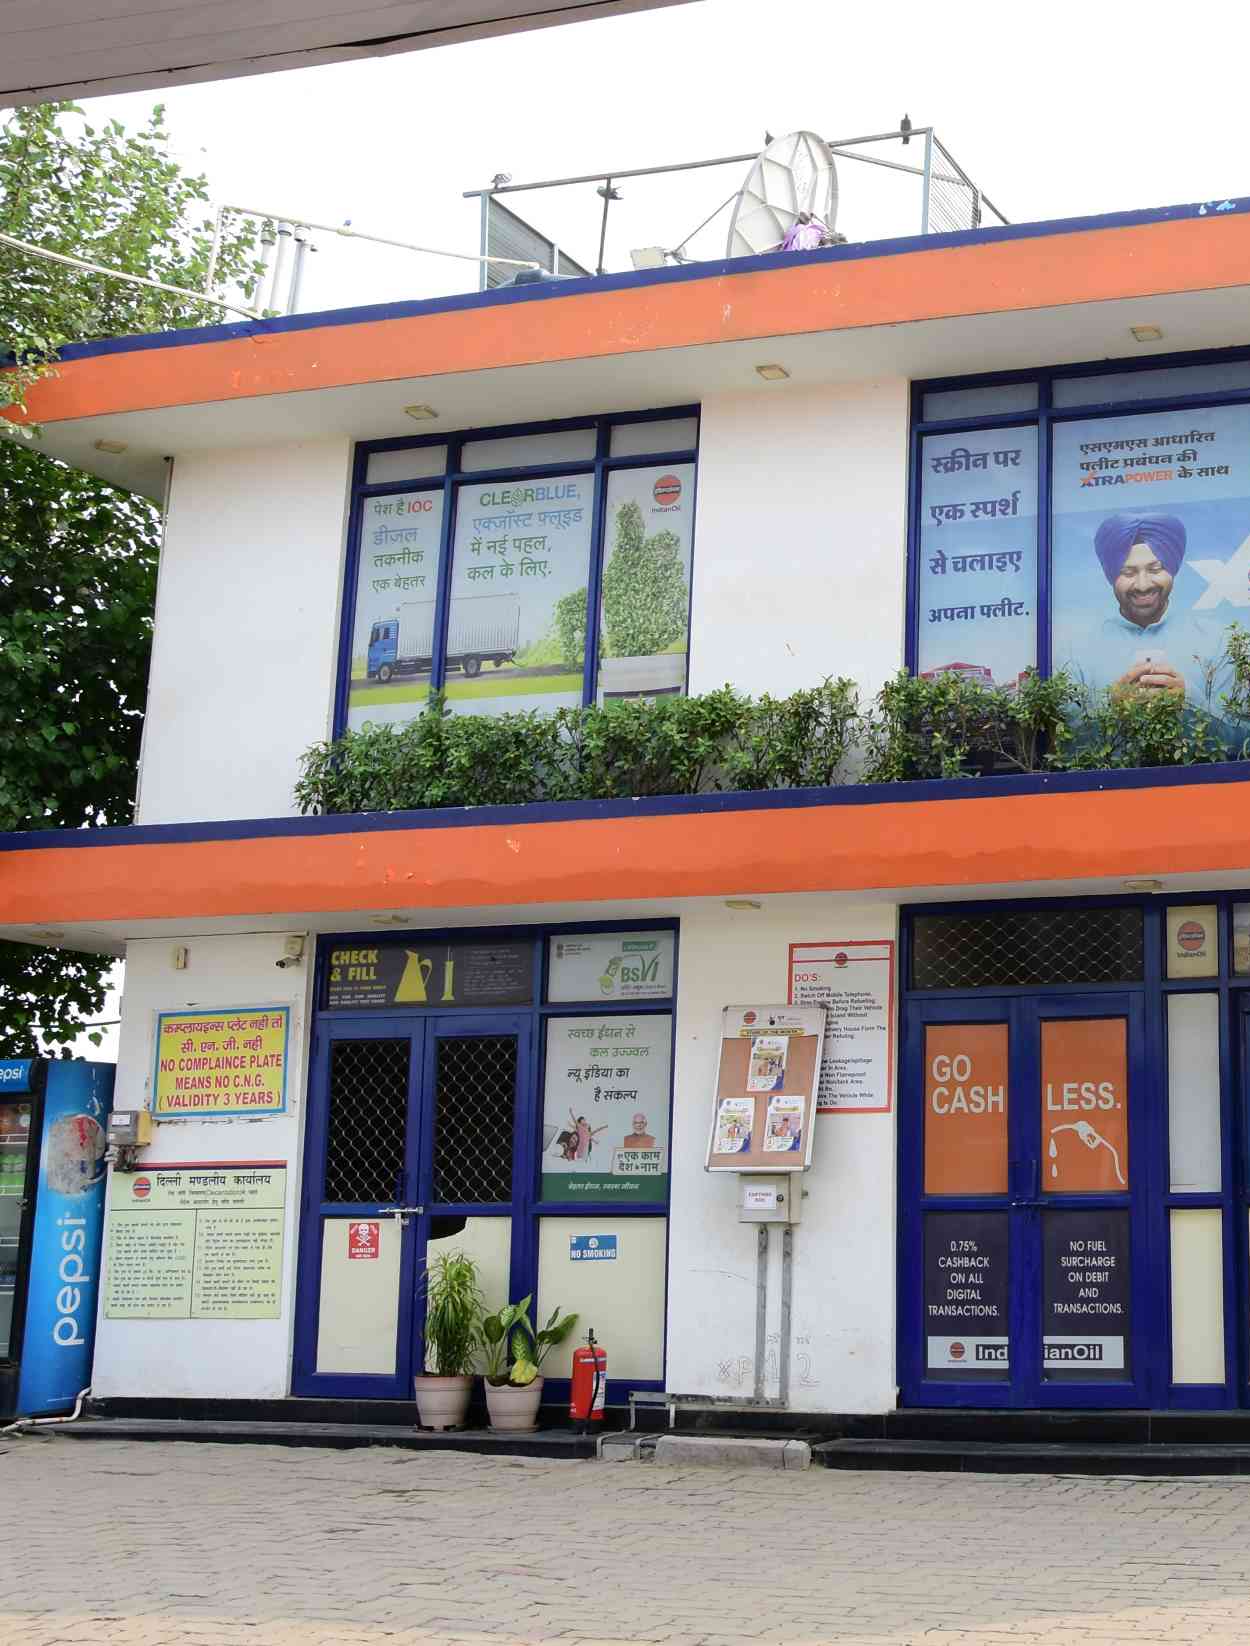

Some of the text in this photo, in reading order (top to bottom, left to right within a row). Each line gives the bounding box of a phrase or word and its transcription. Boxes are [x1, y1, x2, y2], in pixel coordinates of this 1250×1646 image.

[930, 447, 1022, 474] स्क्रीन पर
[1176, 448, 1199, 463] की
[1177, 465, 1193, 479] के
[407, 500, 433, 514] IOC
[930, 490, 1021, 527] एक स्पर्श
[486, 534, 510, 555] नई
[373, 547, 424, 568] तकनीक
[929, 550, 1023, 575] से चलाइए
[467, 558, 515, 583] कल के
[371, 578, 391, 593] एक
[928, 605, 976, 623] अपना
[330, 949, 379, 966] CHECK
[348, 966, 377, 981] FILL
[160, 1053, 283, 1073] NO COMPLAINCE PLATE
[931, 1054, 972, 1083] GO
[615, 1067, 631, 1079] का
[175, 1073, 265, 1091] MEANS NO C.N.G.
[166, 1090, 273, 1108] VALIDITY 3 YEARS
[931, 1085, 1004, 1114] CASH
[1046, 1081, 1122, 1111] LESS.
[156, 1172, 182, 1187] दिल्ली
[950, 1240, 977, 1252] 0.75%
[1069, 1240, 1107, 1251] NO FUEL
[570, 1248, 616, 1259] NO SMOKING
[938, 1256, 990, 1268] CASHBACK
[1060, 1256, 1116, 1267] SURCHARGE
[52, 1213, 91, 1346] pepsi
[950, 1272, 984, 1284] ON ALL
[1067, 1271, 1110, 1283] ON DEBIT
[947, 1289, 982, 1300] DIGITAL
[1078, 1287, 1099, 1298] AND
[928, 1304, 1000, 1317] TRANSACTIONS.
[1053, 1303, 1124, 1314] TRANSACTIONS.
[1044, 1345, 1100, 1360] ianOil
